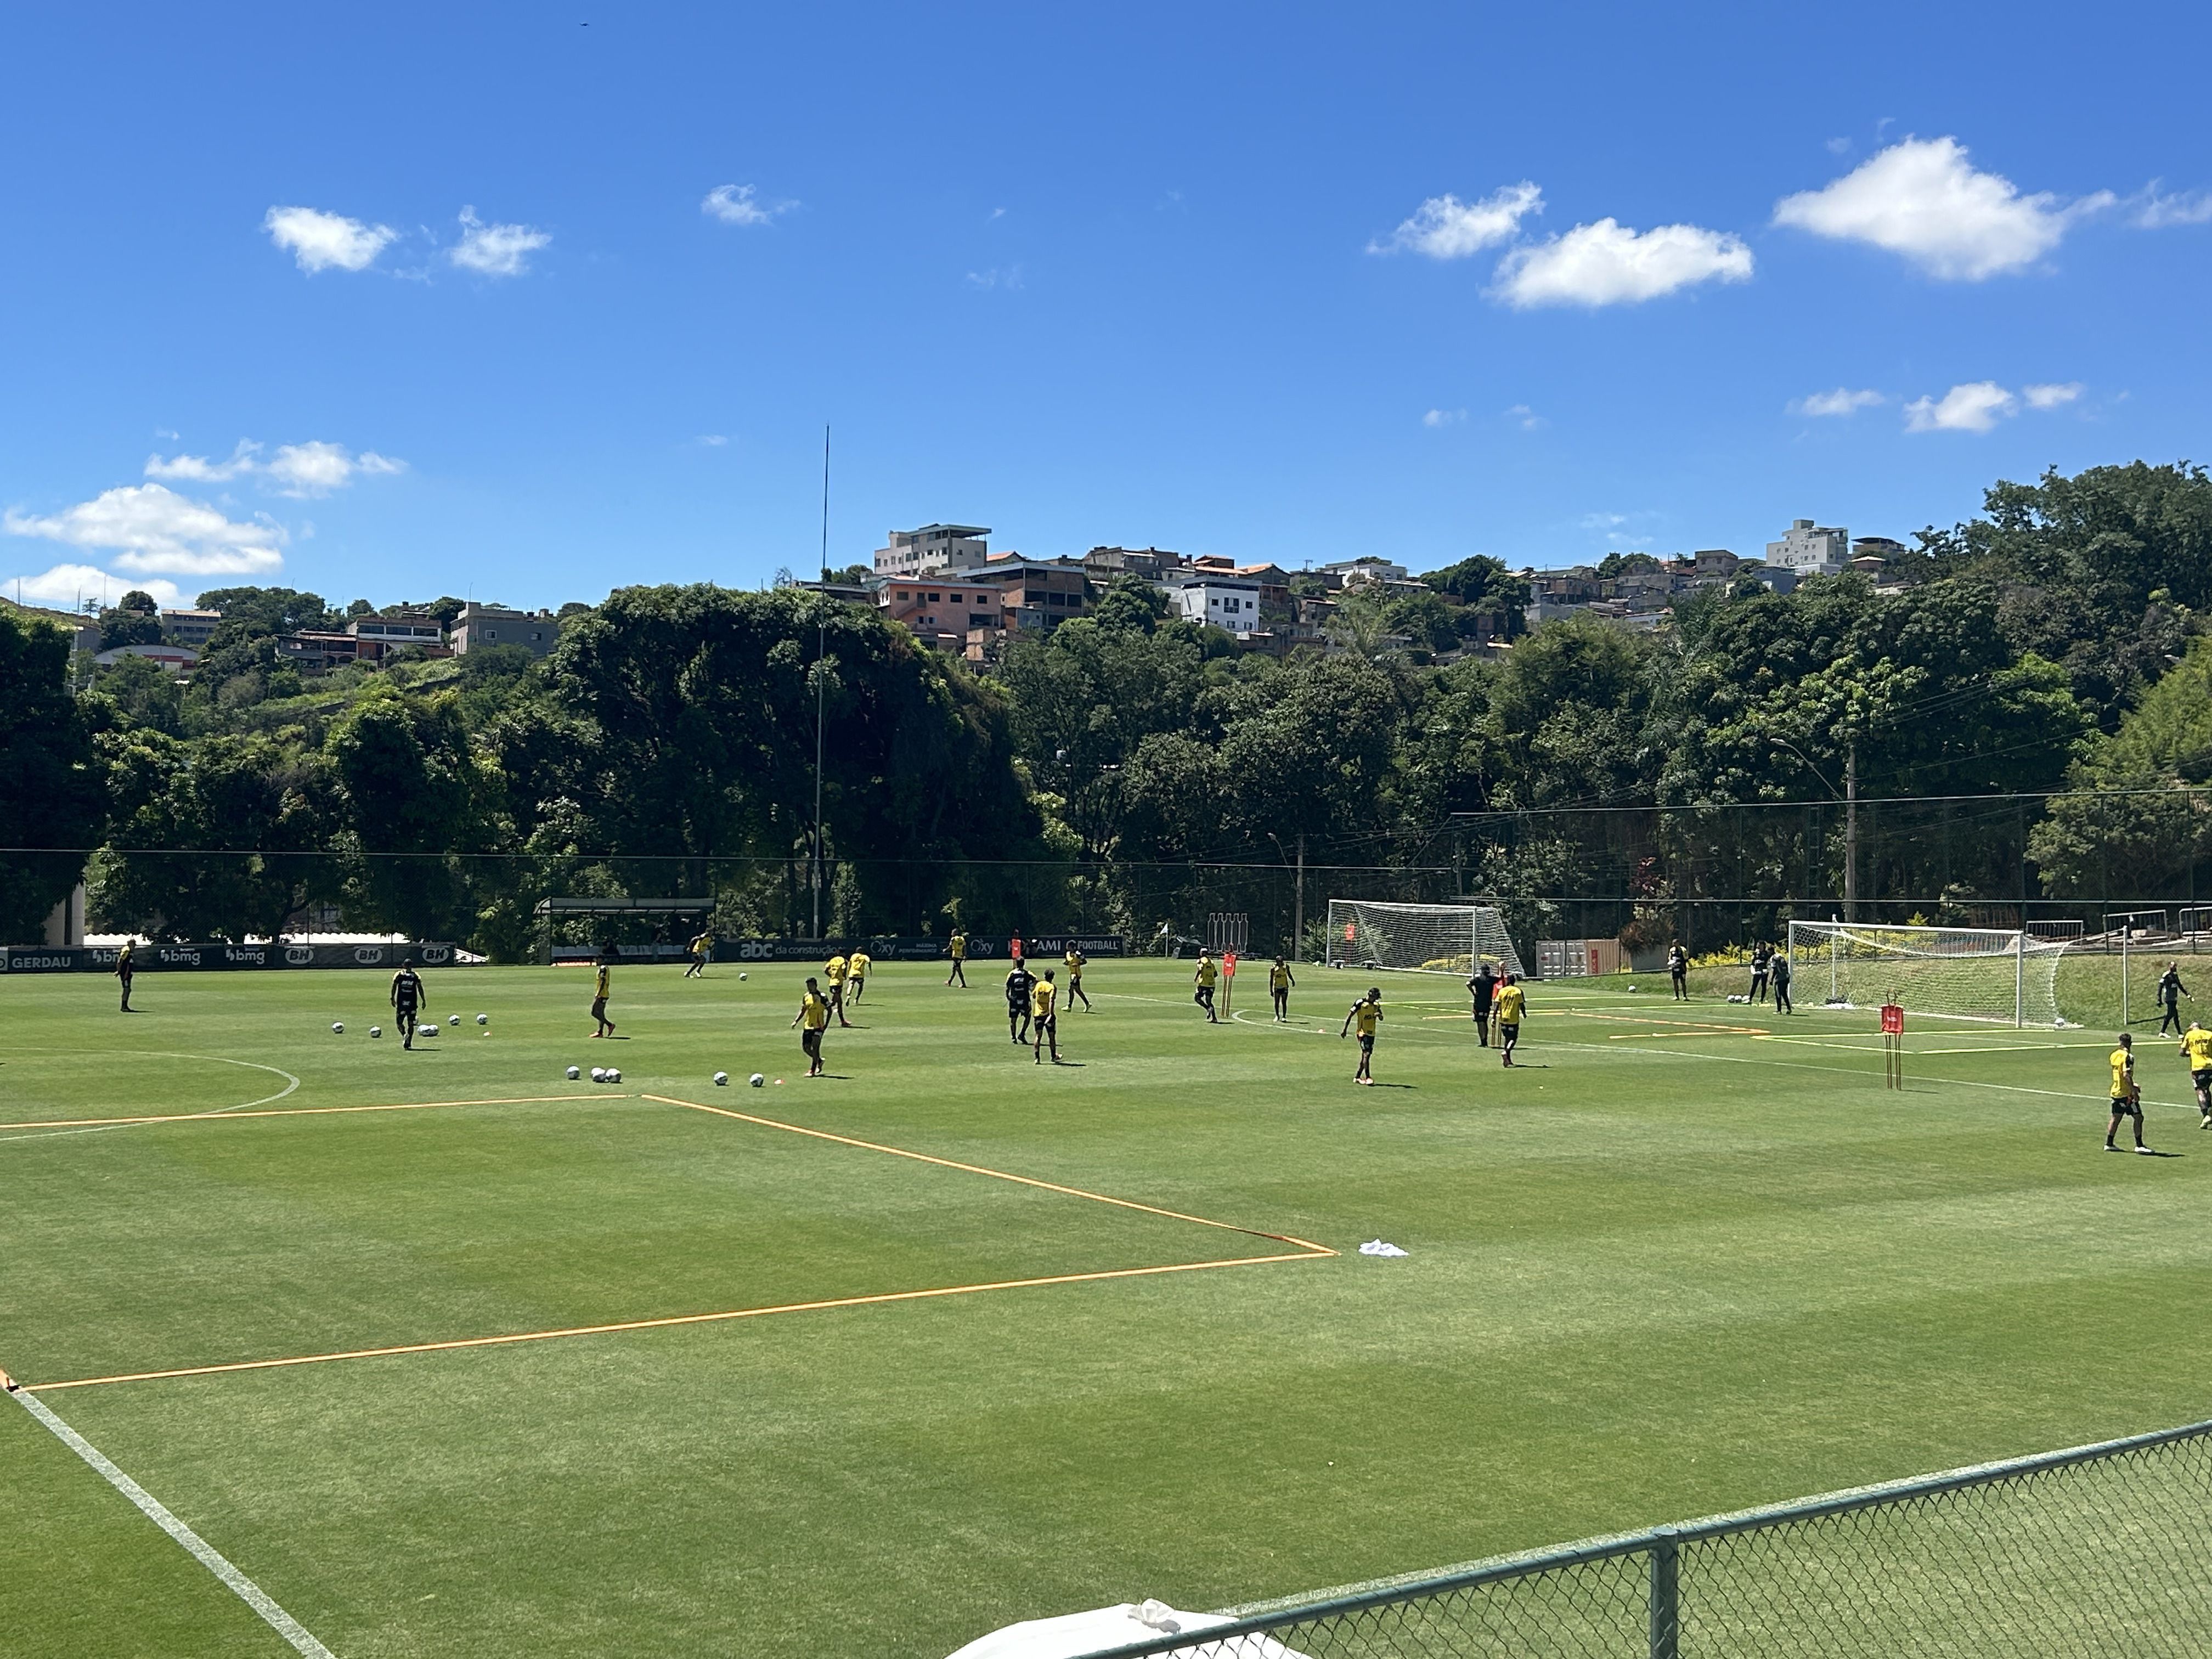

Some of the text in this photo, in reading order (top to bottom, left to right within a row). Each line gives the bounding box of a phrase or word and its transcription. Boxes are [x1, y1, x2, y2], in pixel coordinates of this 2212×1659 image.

[740, 940, 837, 958] abc da construção
[870, 940, 895, 956] Oxy
[970, 938, 994, 955] Oxy
[12, 956, 71, 968] GERDAU
[171, 949, 201, 966] bmg
[236, 949, 265, 964] bmg
[289, 950, 310, 961] BH
[359, 950, 379, 961] BH
[426, 949, 445, 960] BH
